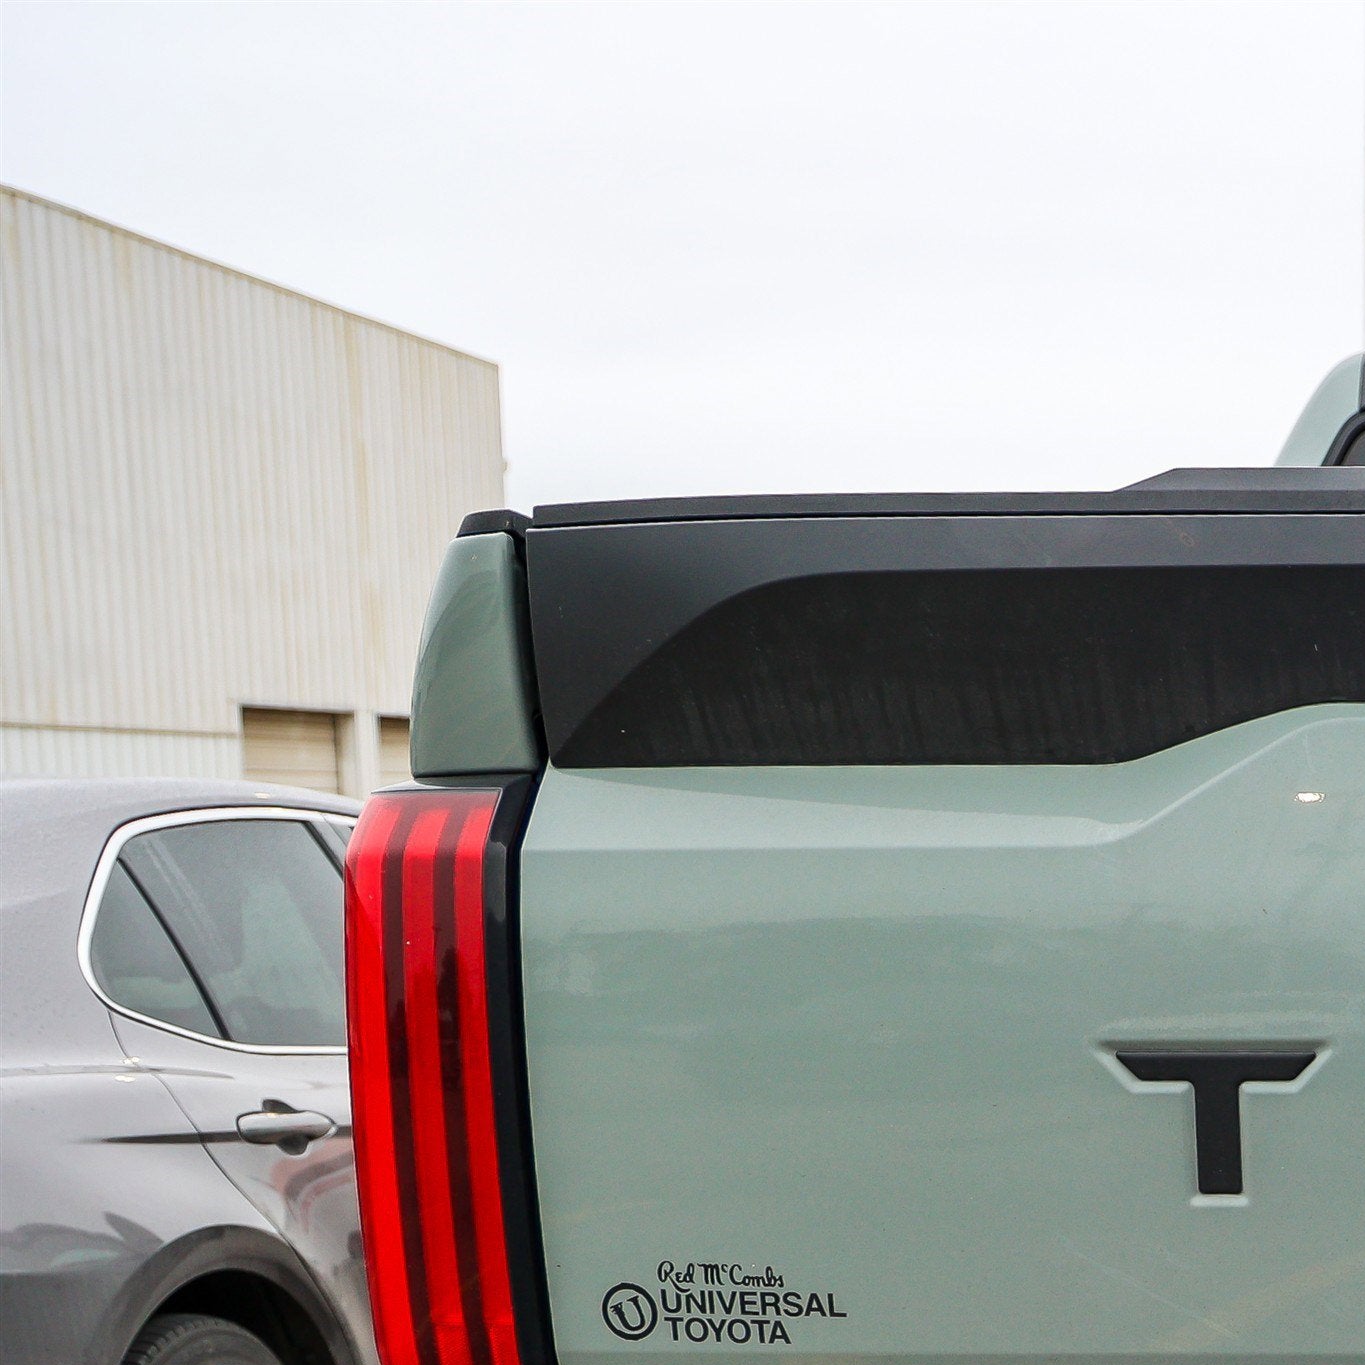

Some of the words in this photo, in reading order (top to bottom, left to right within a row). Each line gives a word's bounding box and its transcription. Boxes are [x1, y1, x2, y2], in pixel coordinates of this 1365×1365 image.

[657, 1260, 695, 1293] Red
[660, 1289, 847, 1318] UNIVERSAL
[664, 1316, 792, 1345] TOYOTA
